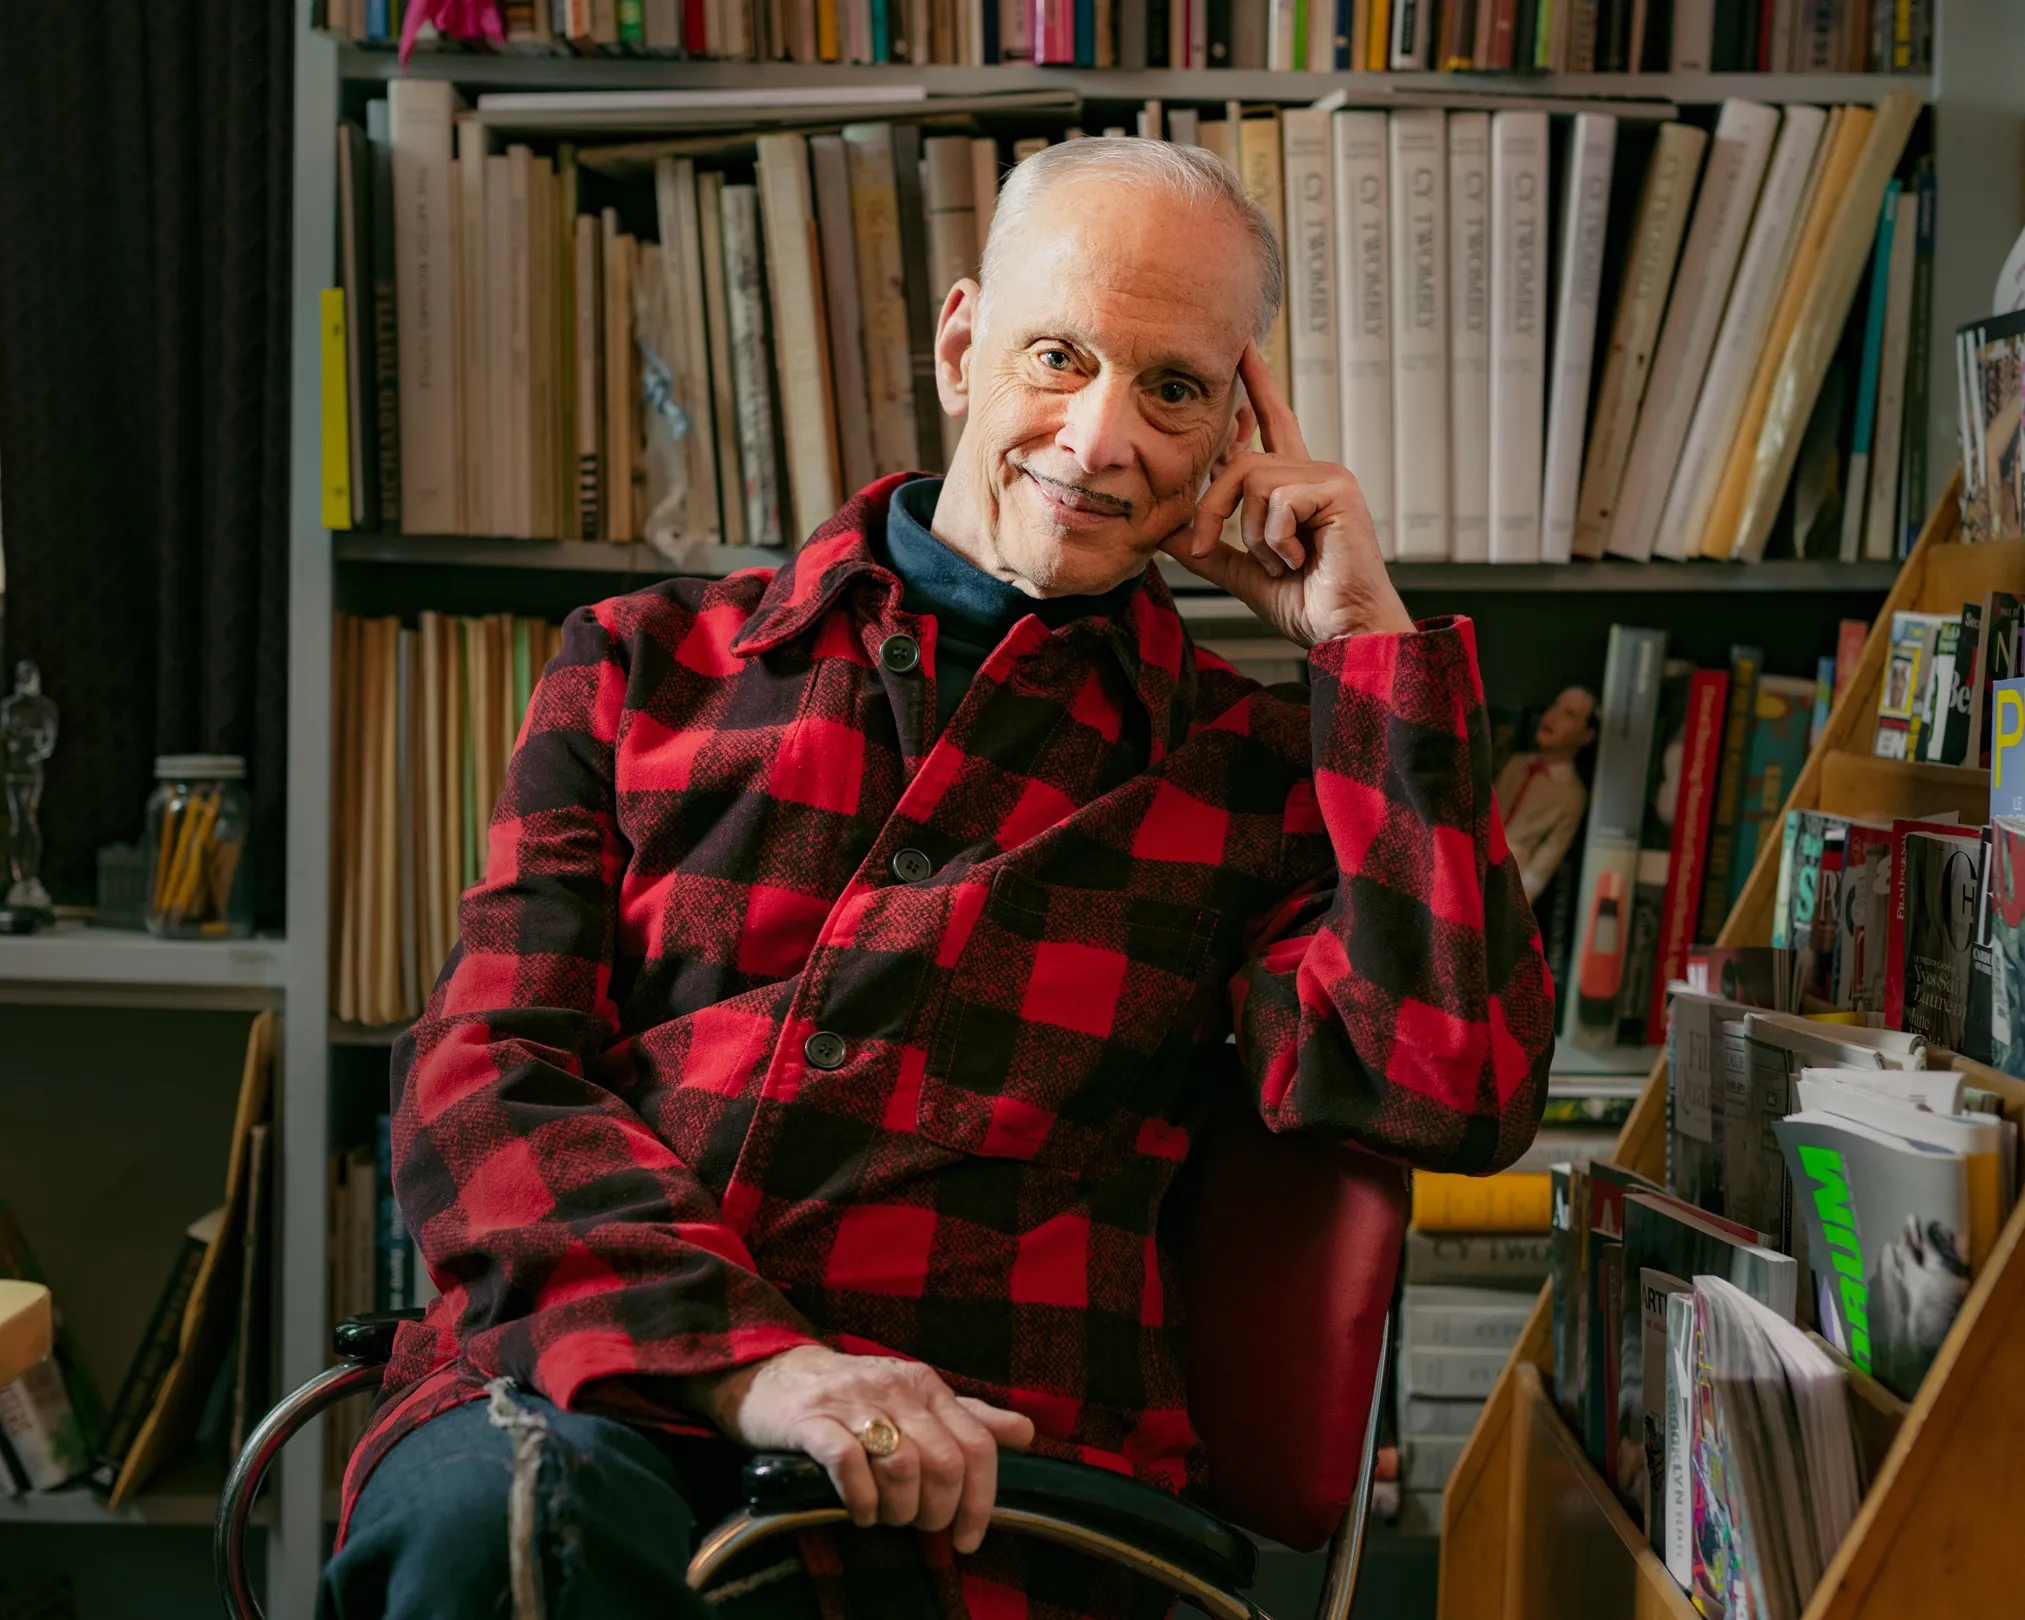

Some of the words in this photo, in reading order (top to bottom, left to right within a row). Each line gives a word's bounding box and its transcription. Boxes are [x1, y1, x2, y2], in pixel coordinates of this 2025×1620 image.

[1303, 172, 1326, 206] CY
[1358, 174, 1382, 209] CY
[1413, 167, 1436, 201] CY
[1464, 170, 1485, 203] CY
[1514, 171, 1537, 206] CY
[1306, 217, 1330, 338] TWOMBLY
[1361, 219, 1384, 339] TWOMBLY
[1413, 212, 1437, 333] TWOMBLY
[1464, 215, 1485, 335] TWOMBLY
[1514, 214, 1537, 339] TWOMBLY
[374, 278, 397, 385] TUTTLE
[380, 388, 400, 520] RICHARD
[1913, 964, 1936, 987] Yves
[1909, 1008, 1931, 1031] Jane
[1432, 1239, 1474, 1262] CY
[1667, 1388, 1685, 1506] BROOKLYN
